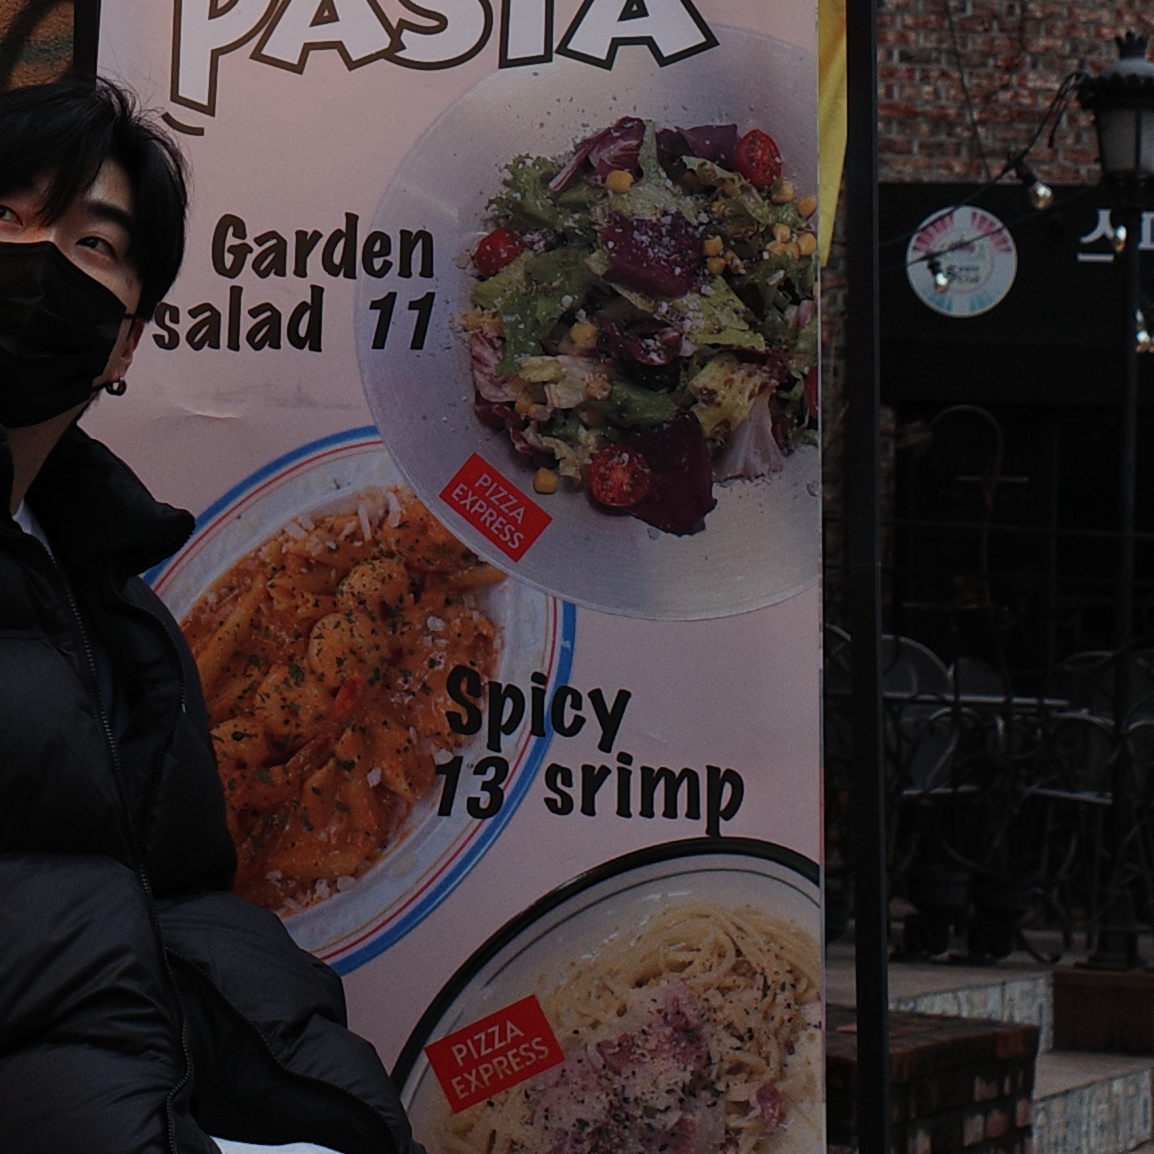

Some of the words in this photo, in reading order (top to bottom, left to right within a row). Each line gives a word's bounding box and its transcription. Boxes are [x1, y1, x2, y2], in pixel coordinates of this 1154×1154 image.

[212, 212, 434, 279] Garden
[1076, 207, 1154, 263] 스
[152, 285, 324, 351] salad
[369, 292, 435, 350] 11
[451, 483, 525, 550] EXPRESS
[474, 473, 526, 525] PIZZA
[446, 665, 631, 752] Spicy
[436, 756, 509, 819] 13
[544, 752, 744, 837] srimp
[451, 1019, 525, 1067] PIZZA
[451, 1036, 549, 1099] EXPRESS
